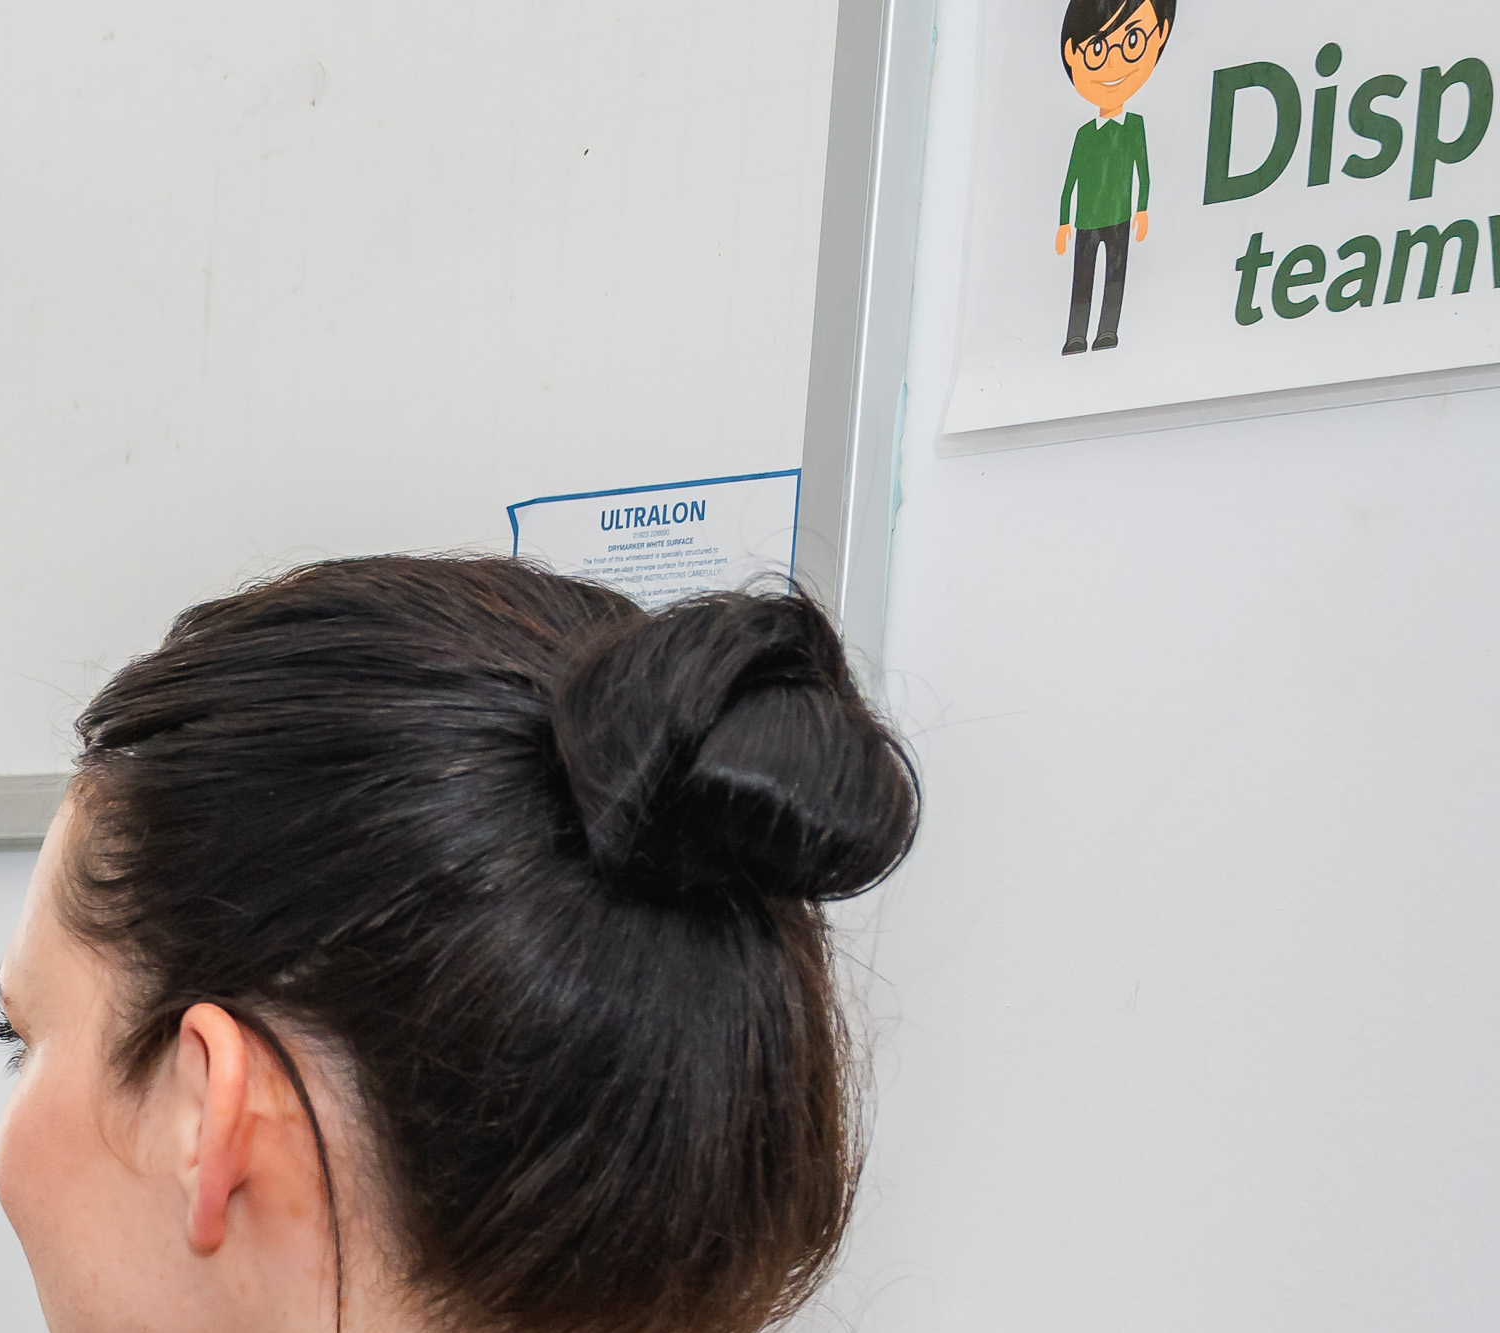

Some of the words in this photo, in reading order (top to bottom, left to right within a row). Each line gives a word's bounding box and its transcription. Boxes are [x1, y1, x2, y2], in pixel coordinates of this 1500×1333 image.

[1203, 42, 1494, 206] Disp
[1235, 214, 1500, 326] team
[601, 499, 706, 531] ULTRALON
[608, 543, 645, 552] DRYMARKER
[646, 540, 665, 549] WHITE
[666, 537, 694, 547] SURFACE
[625, 552, 654, 561] whiteboard
[661, 550, 683, 559] specially
[685, 547, 712, 556] structured
[657, 561, 676, 569] surface
[686, 559, 713, 568] drymarker
